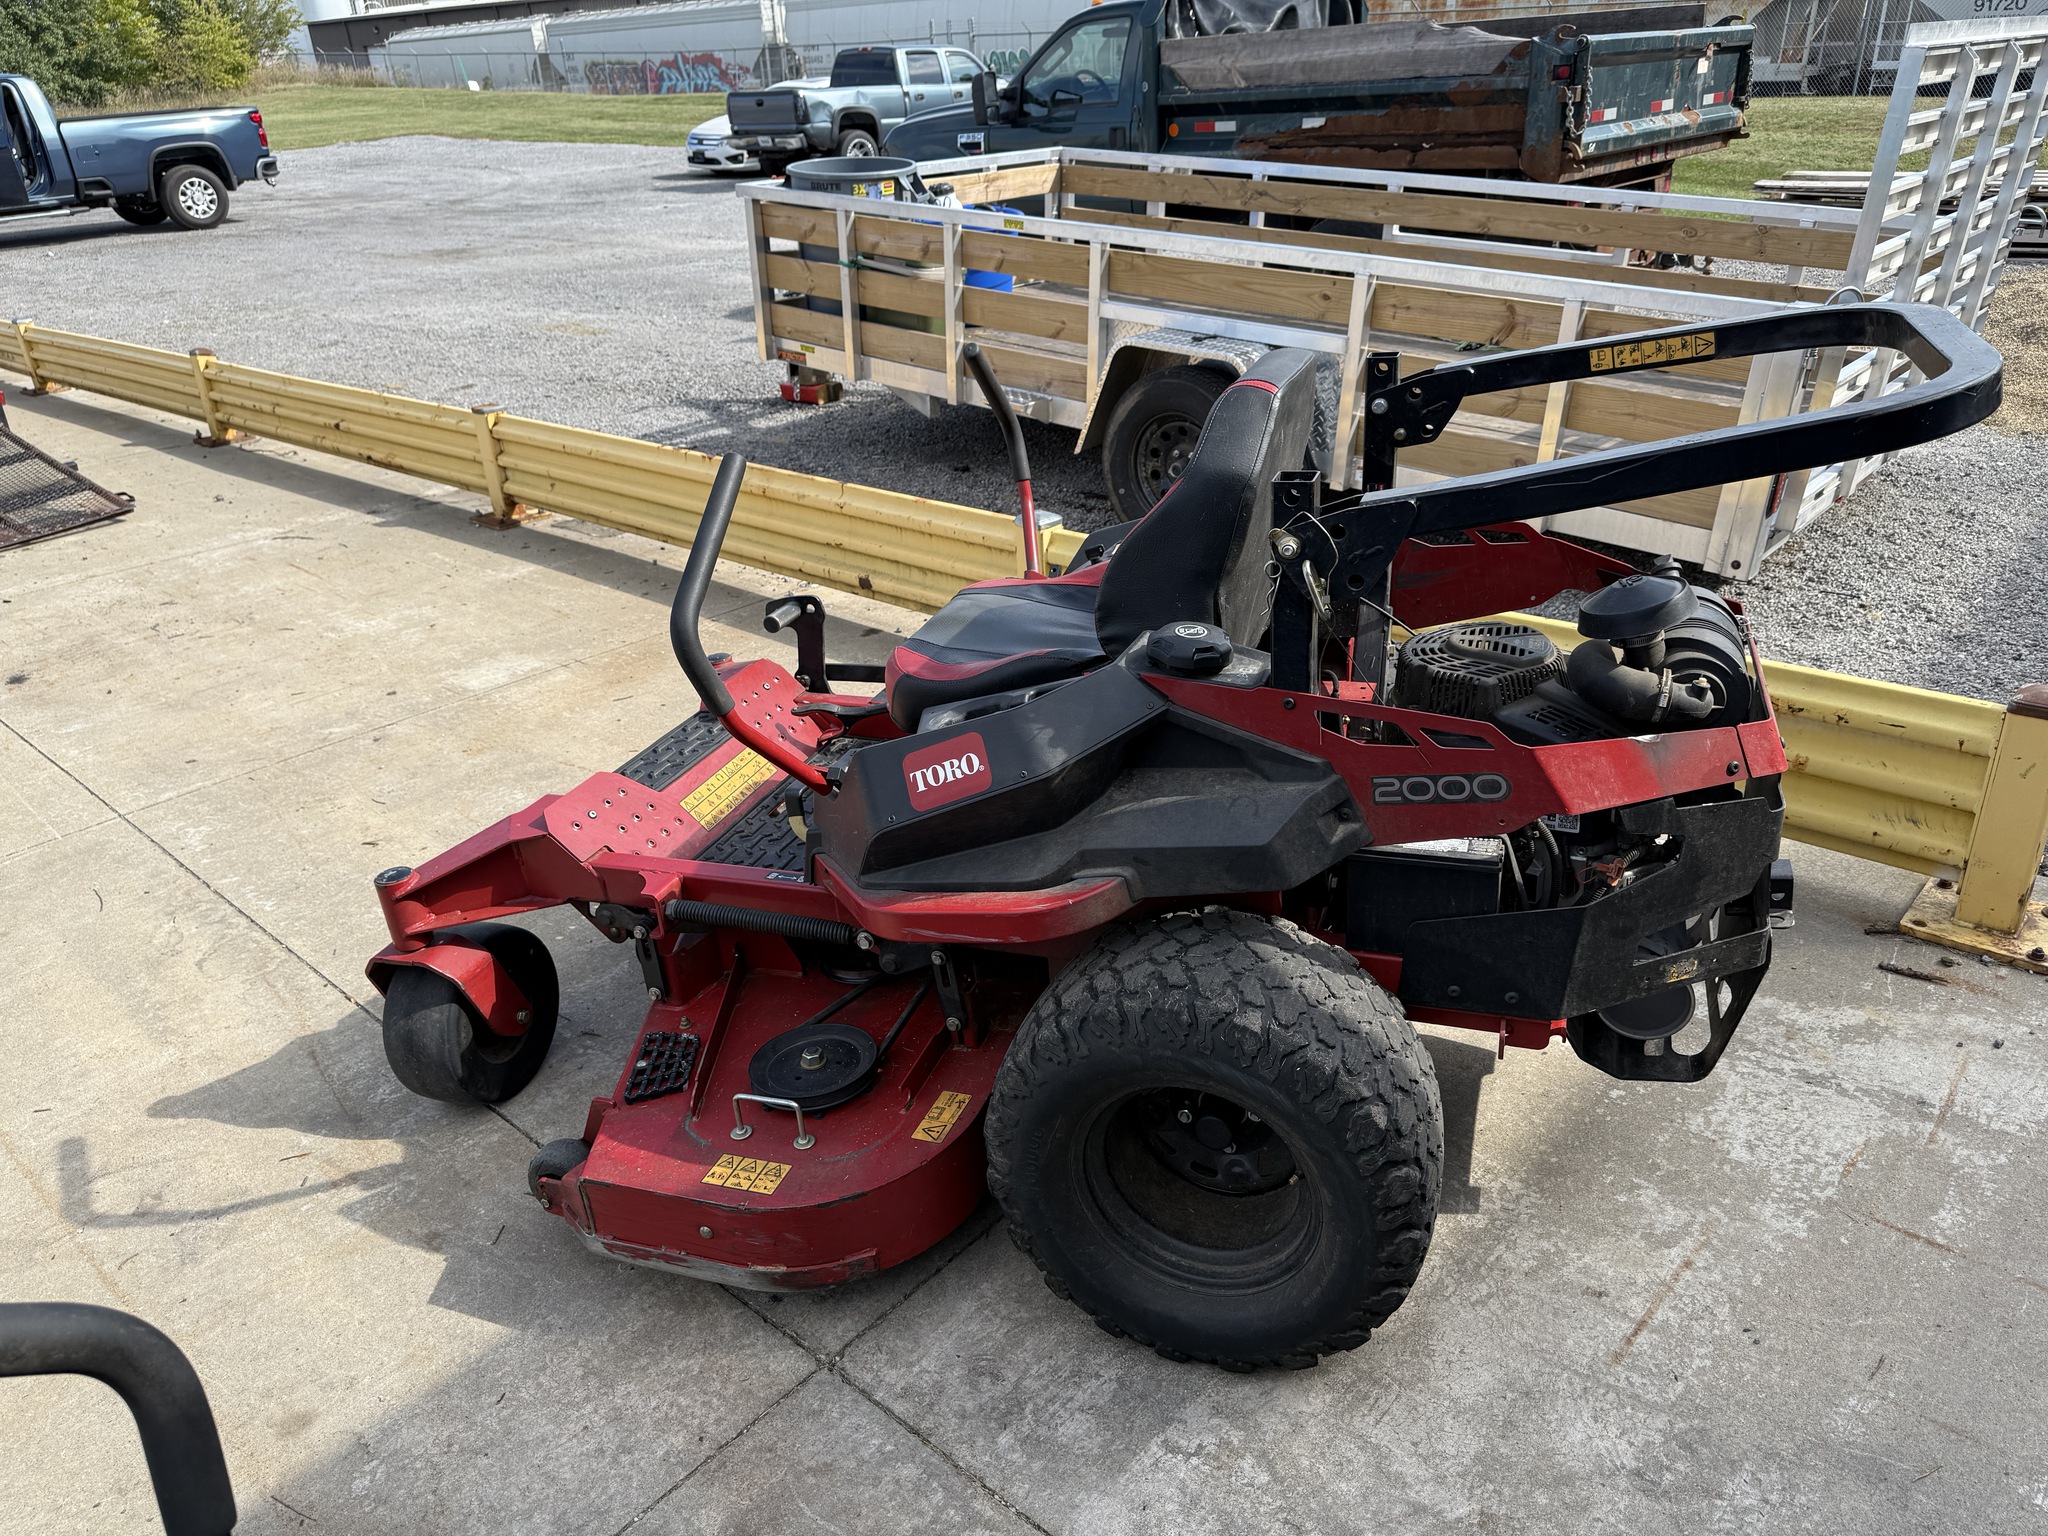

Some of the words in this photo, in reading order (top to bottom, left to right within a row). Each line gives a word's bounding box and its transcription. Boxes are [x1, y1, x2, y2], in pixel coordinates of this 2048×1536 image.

[1973, 0, 2028, 12] 91720
[810, 181, 842, 192] BRUTE
[852, 183, 867, 195] 3X
[909, 752, 981, 793] TORO
[1373, 774, 1508, 802] 2000
